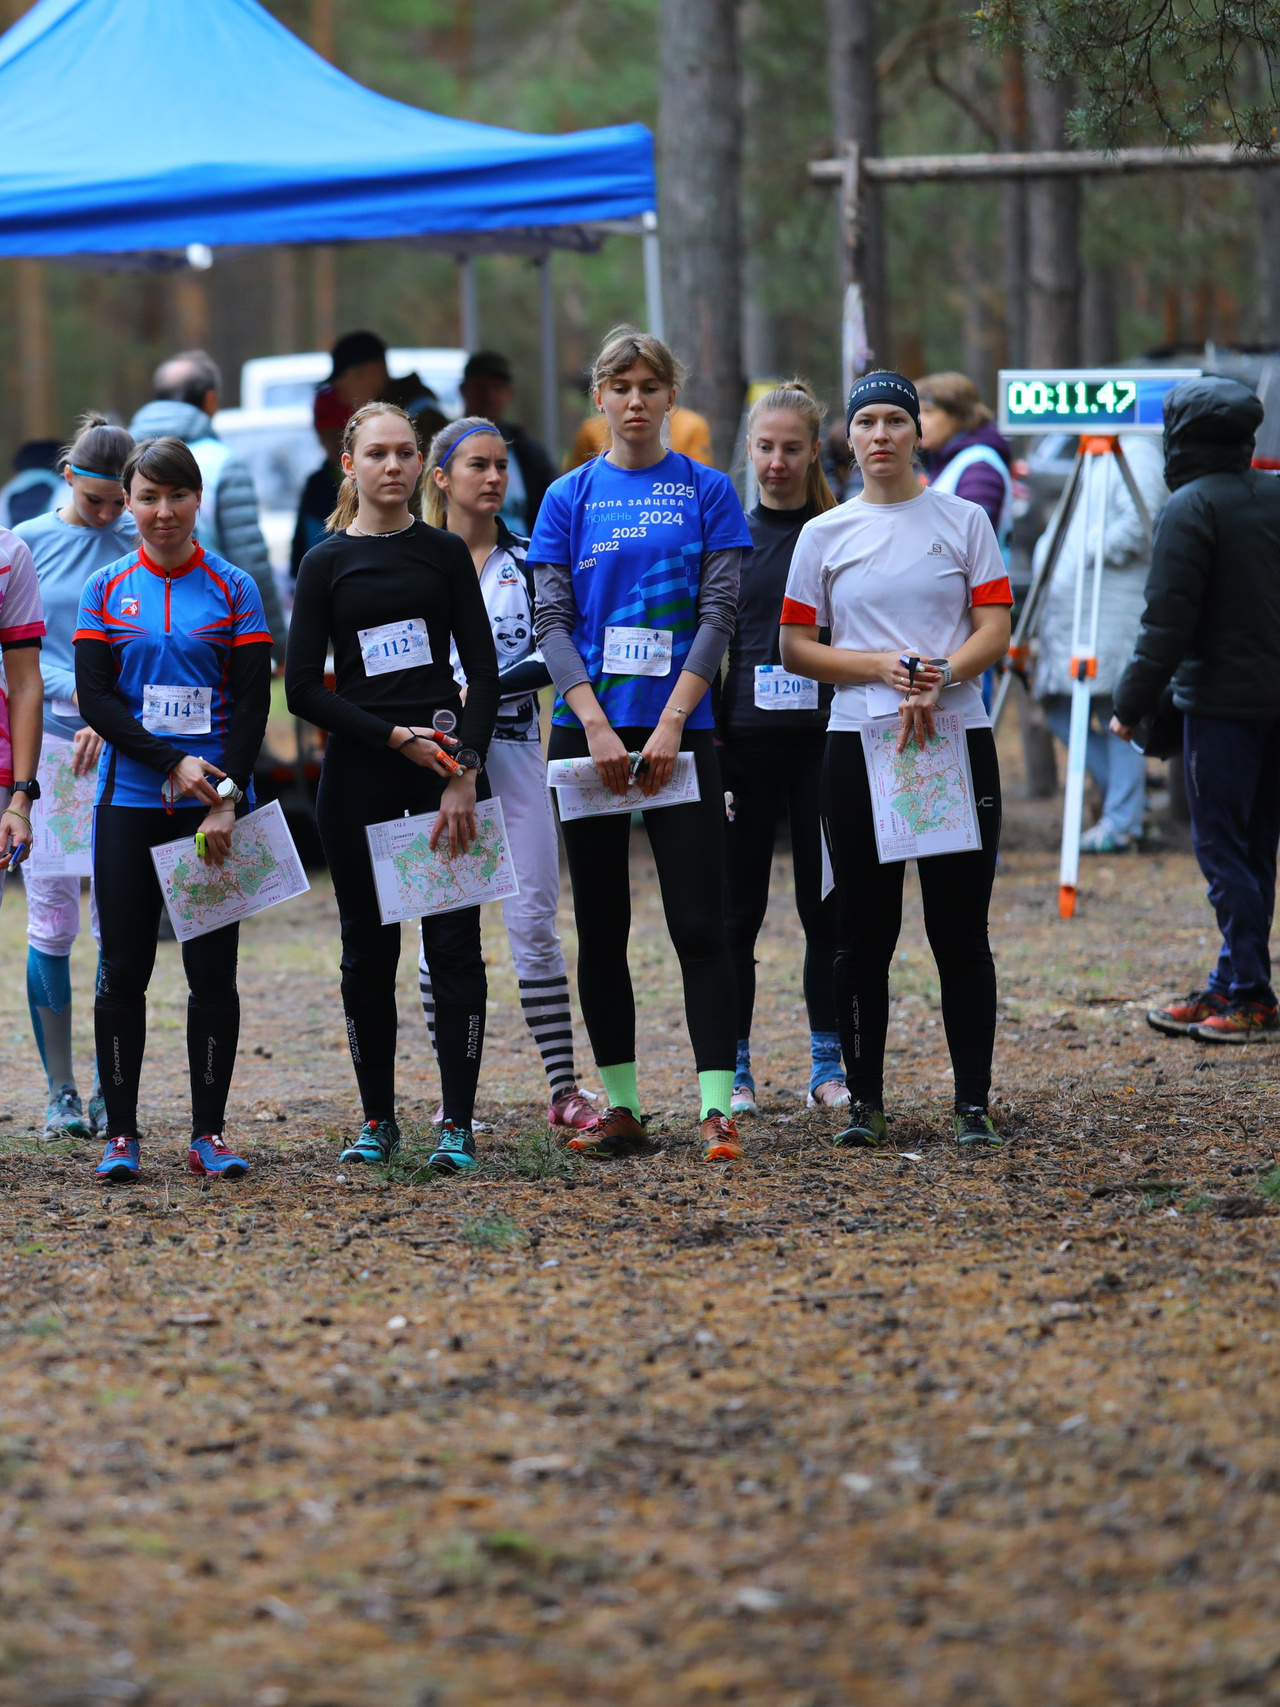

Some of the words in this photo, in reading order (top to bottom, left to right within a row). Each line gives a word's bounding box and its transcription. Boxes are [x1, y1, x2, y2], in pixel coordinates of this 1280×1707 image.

[1008, 380, 1136, 414] 00:11.47
[652, 482, 695, 498] 2025
[584, 500, 622, 510] ТРОПА
[628, 497, 684, 507] ЗАЙЦЕВА
[586, 512, 632, 526] ТЮМЕНЬ
[638, 511, 684, 526] 2024
[612, 527, 647, 539] 2023
[592, 541, 620, 554] 2022
[579, 557, 597, 570] 2021
[382, 638, 410, 657] 112
[625, 644, 648, 659] 111
[774, 680, 800, 694] 120
[164, 702, 191, 717] 114
[467, 1015, 480, 1058] noname
[207, 1036, 217, 1072] NORD
